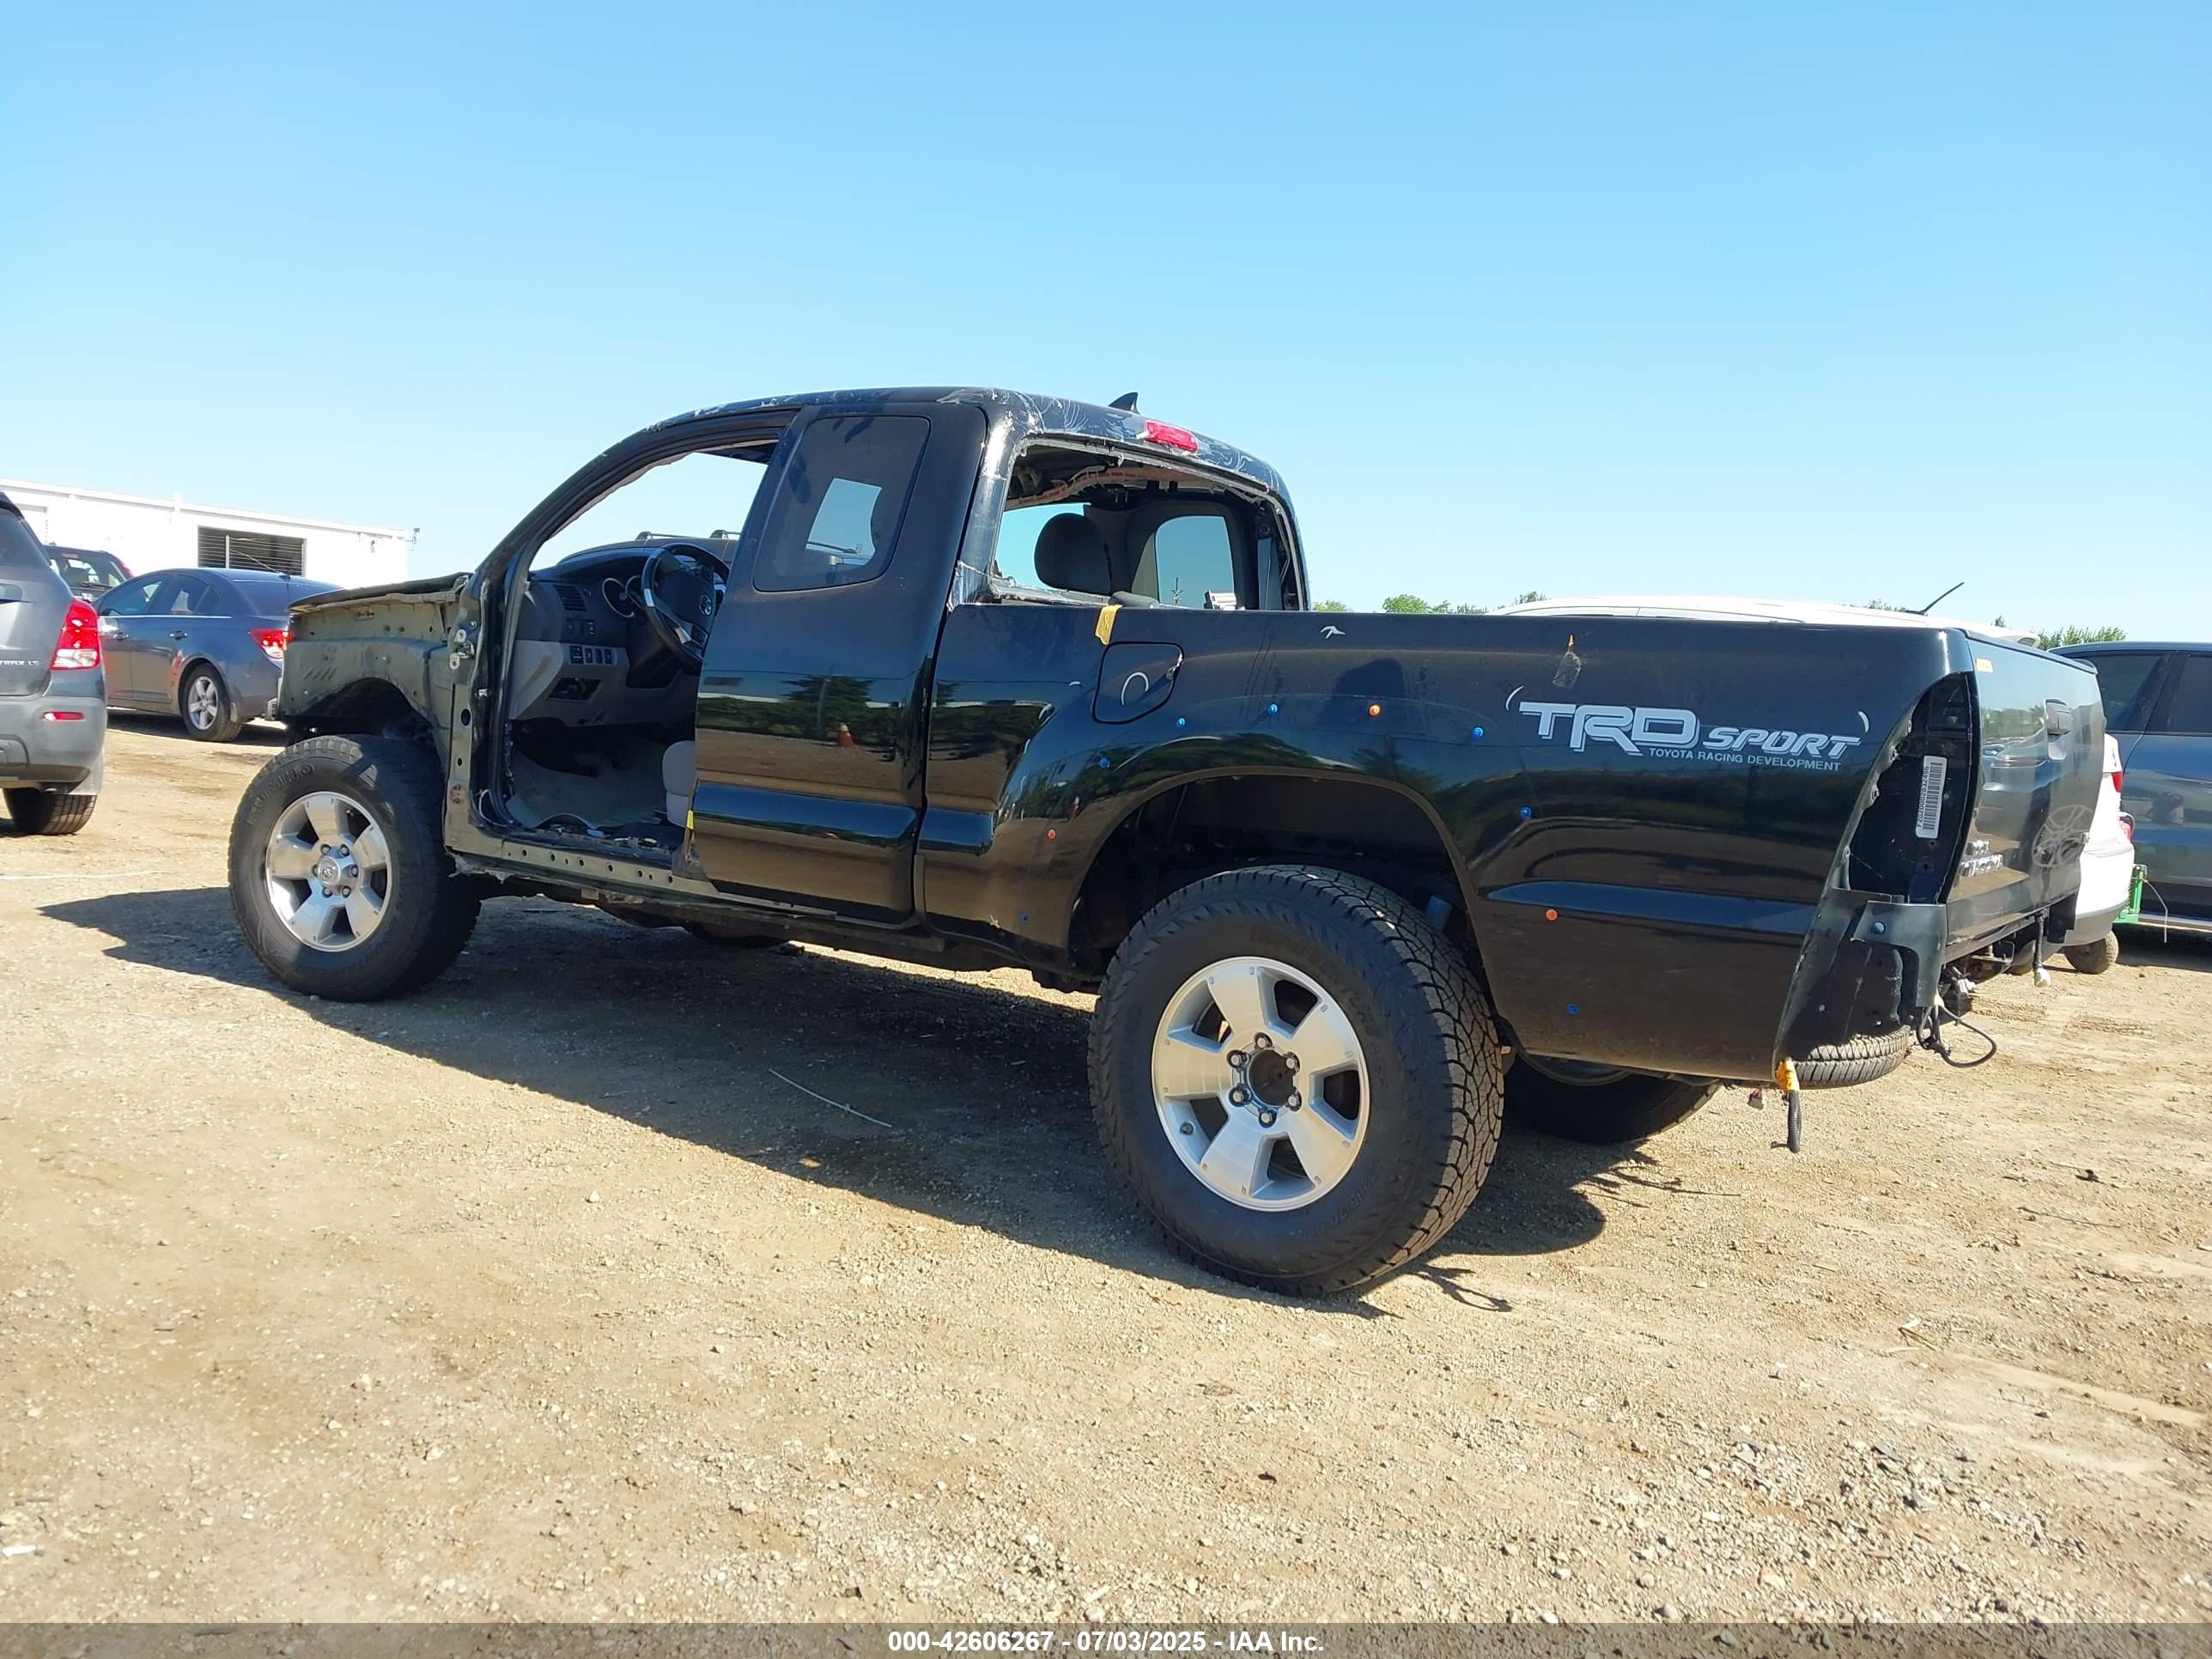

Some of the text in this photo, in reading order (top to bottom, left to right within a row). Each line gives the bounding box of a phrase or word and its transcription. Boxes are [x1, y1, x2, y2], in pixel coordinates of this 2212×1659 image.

[1518, 700, 1863, 760] TRD SPORT
[1649, 746, 1842, 772] TOYOTA RACING DEVELOPMENT
